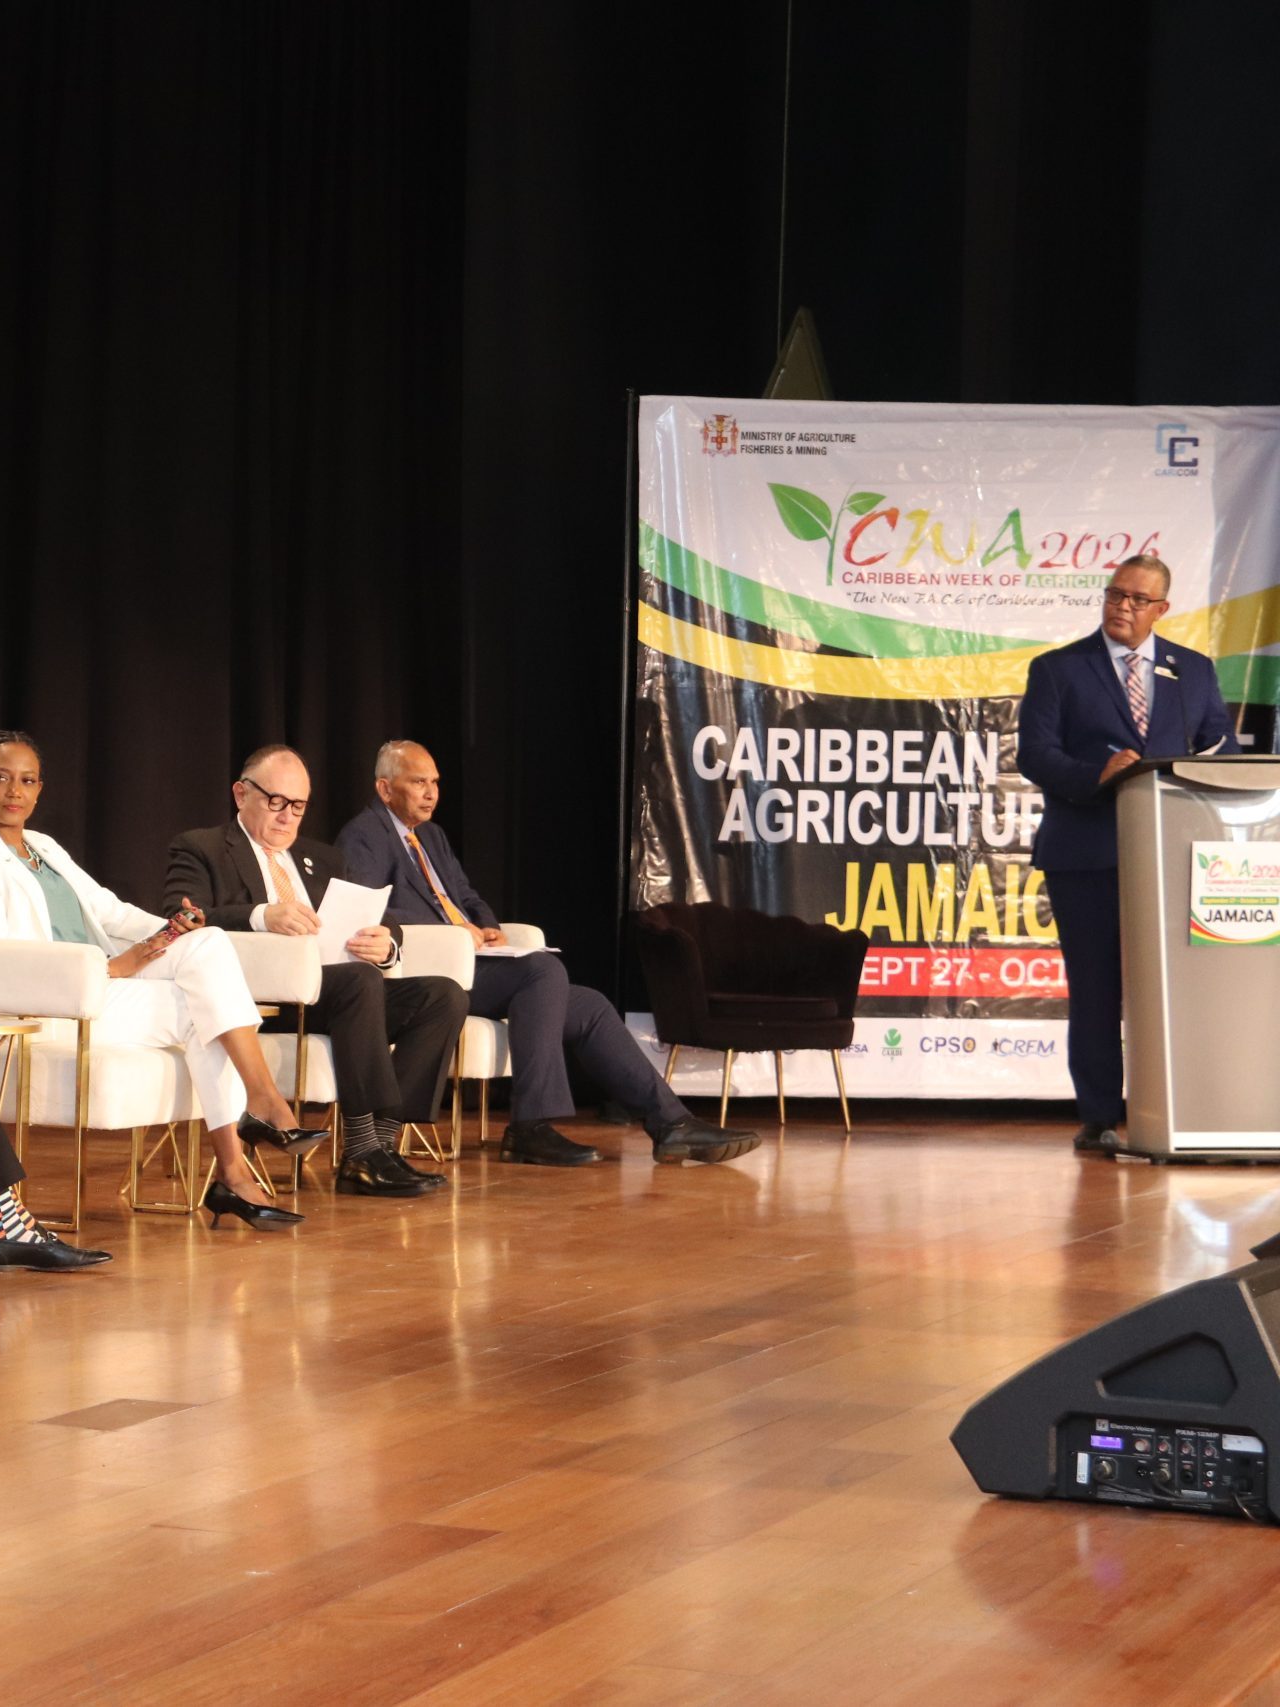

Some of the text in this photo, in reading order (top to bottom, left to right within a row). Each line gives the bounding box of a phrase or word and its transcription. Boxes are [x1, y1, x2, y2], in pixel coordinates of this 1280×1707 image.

[741, 431, 856, 443] MINISTRY OF AGRICULTURE
[740, 444, 827, 456] FISHERIES & MINING
[842, 571, 940, 586] CARIBBEAN
[945, 573, 993, 586] WEEK
[999, 574, 1021, 587] OF
[986, 594, 1054, 606] Caribbean
[692, 725, 998, 785] CARIBBEAN
[1204, 909, 1274, 923] JAMAICA
[932, 957, 971, 987] 27
[1001, 957, 1067, 987] OCT
[920, 1037, 976, 1053] CPSO
